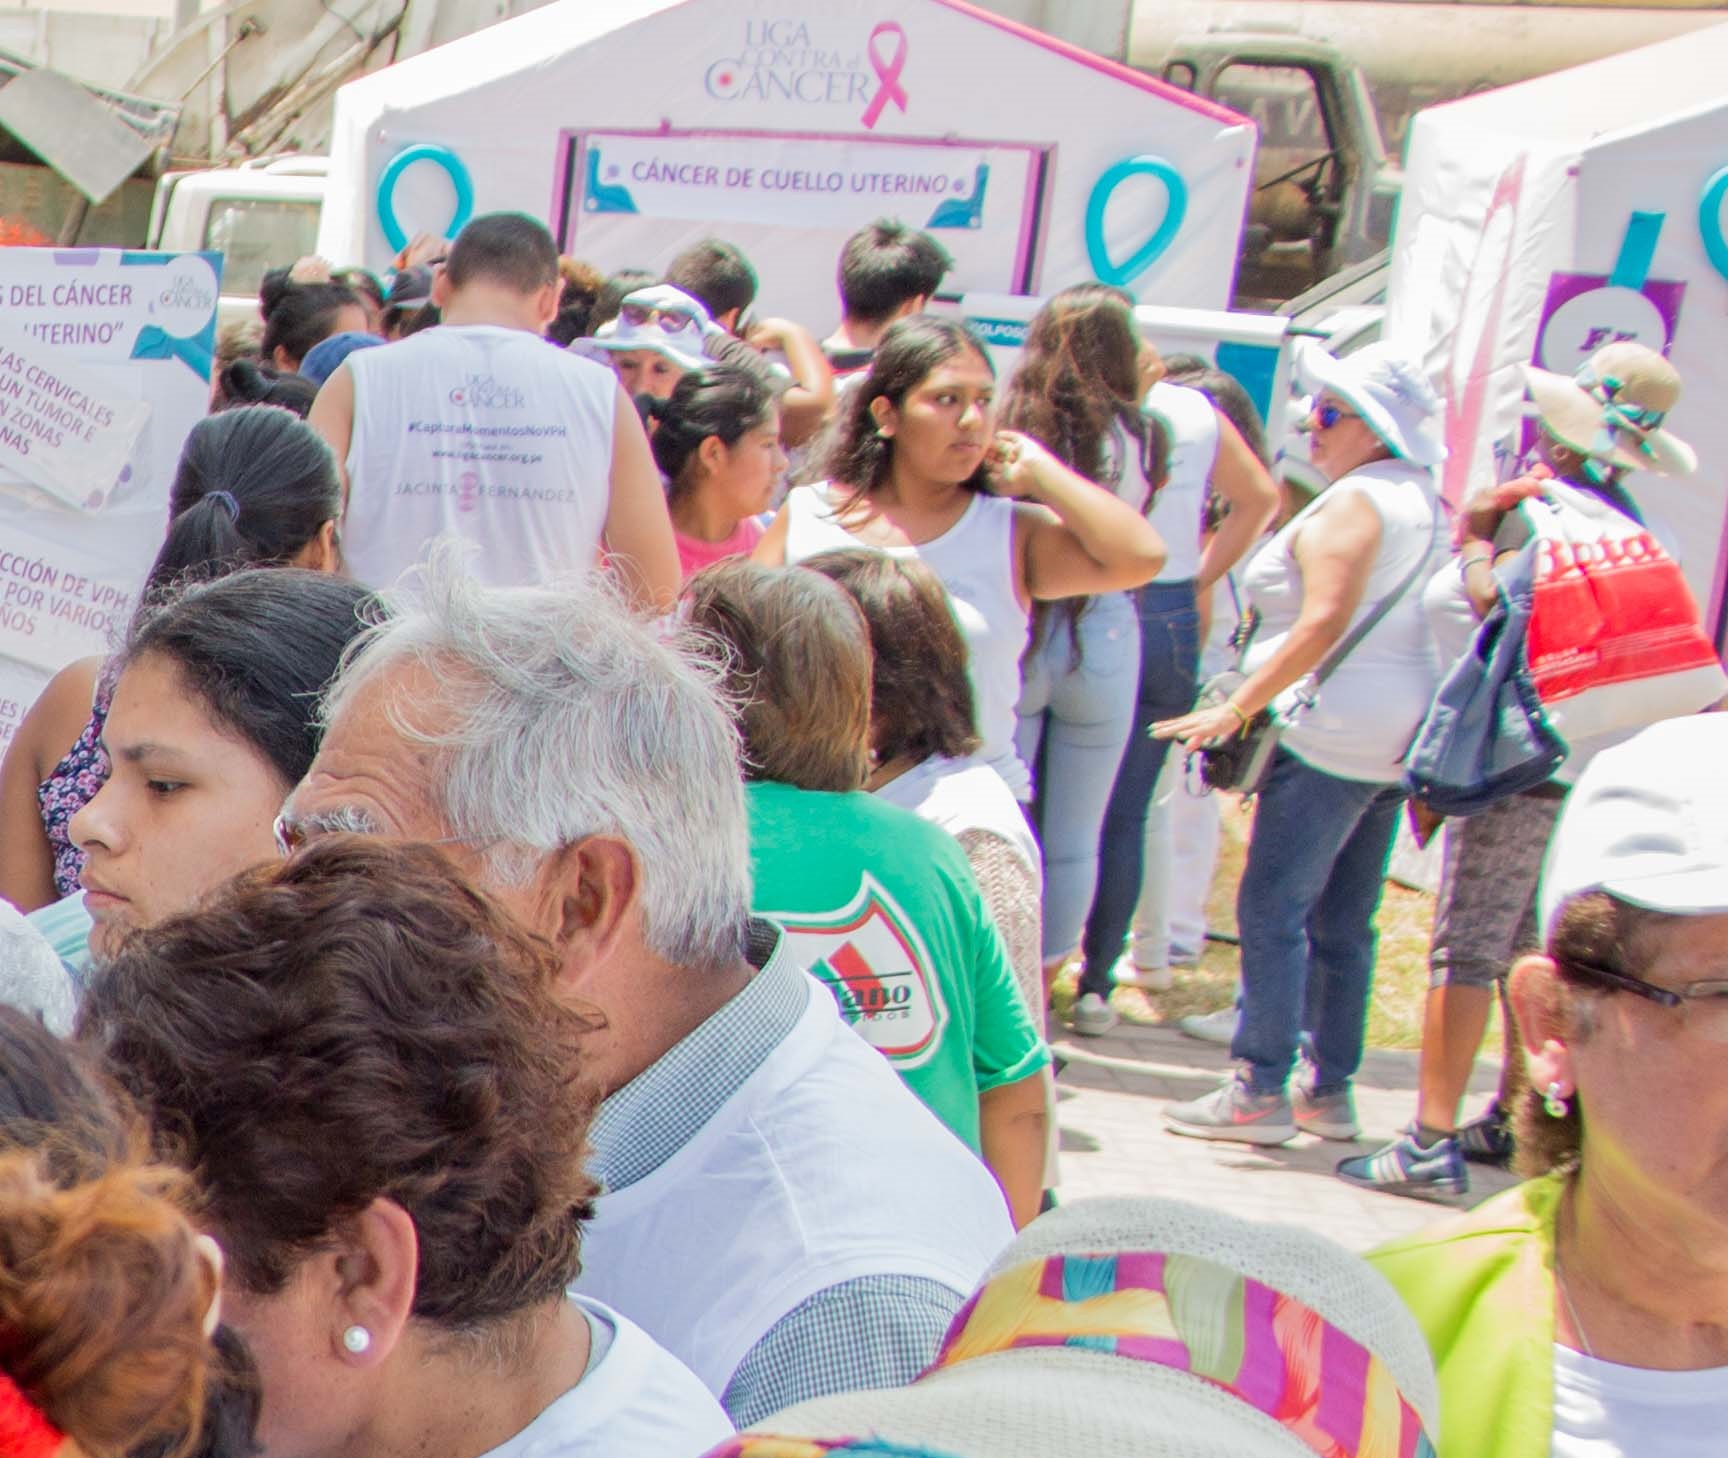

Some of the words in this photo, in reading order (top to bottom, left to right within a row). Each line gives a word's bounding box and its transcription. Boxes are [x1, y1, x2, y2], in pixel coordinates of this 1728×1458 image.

[745, 18, 811, 48] LIGA
[742, 49, 841, 69] CONTRA
[631, 157, 718, 185] CÁNCER
[725, 167, 753, 187] DE
[760, 169, 843, 192] CUELLO
[851, 172, 948, 193] UTERINO
[10, 284, 47, 307] DEL
[60, 279, 133, 307] CÁNCER
[25, 364, 117, 428] CERVICALES
[9, 407, 66, 449] ZONAS
[25, 389, 83, 433] TUMOR
[84, 426, 97, 444] E
[4, 580, 45, 611] POR
[49, 596, 115, 635] VARIOS
[61, 573, 88, 598] DE
[92, 581, 129, 611] VPH
